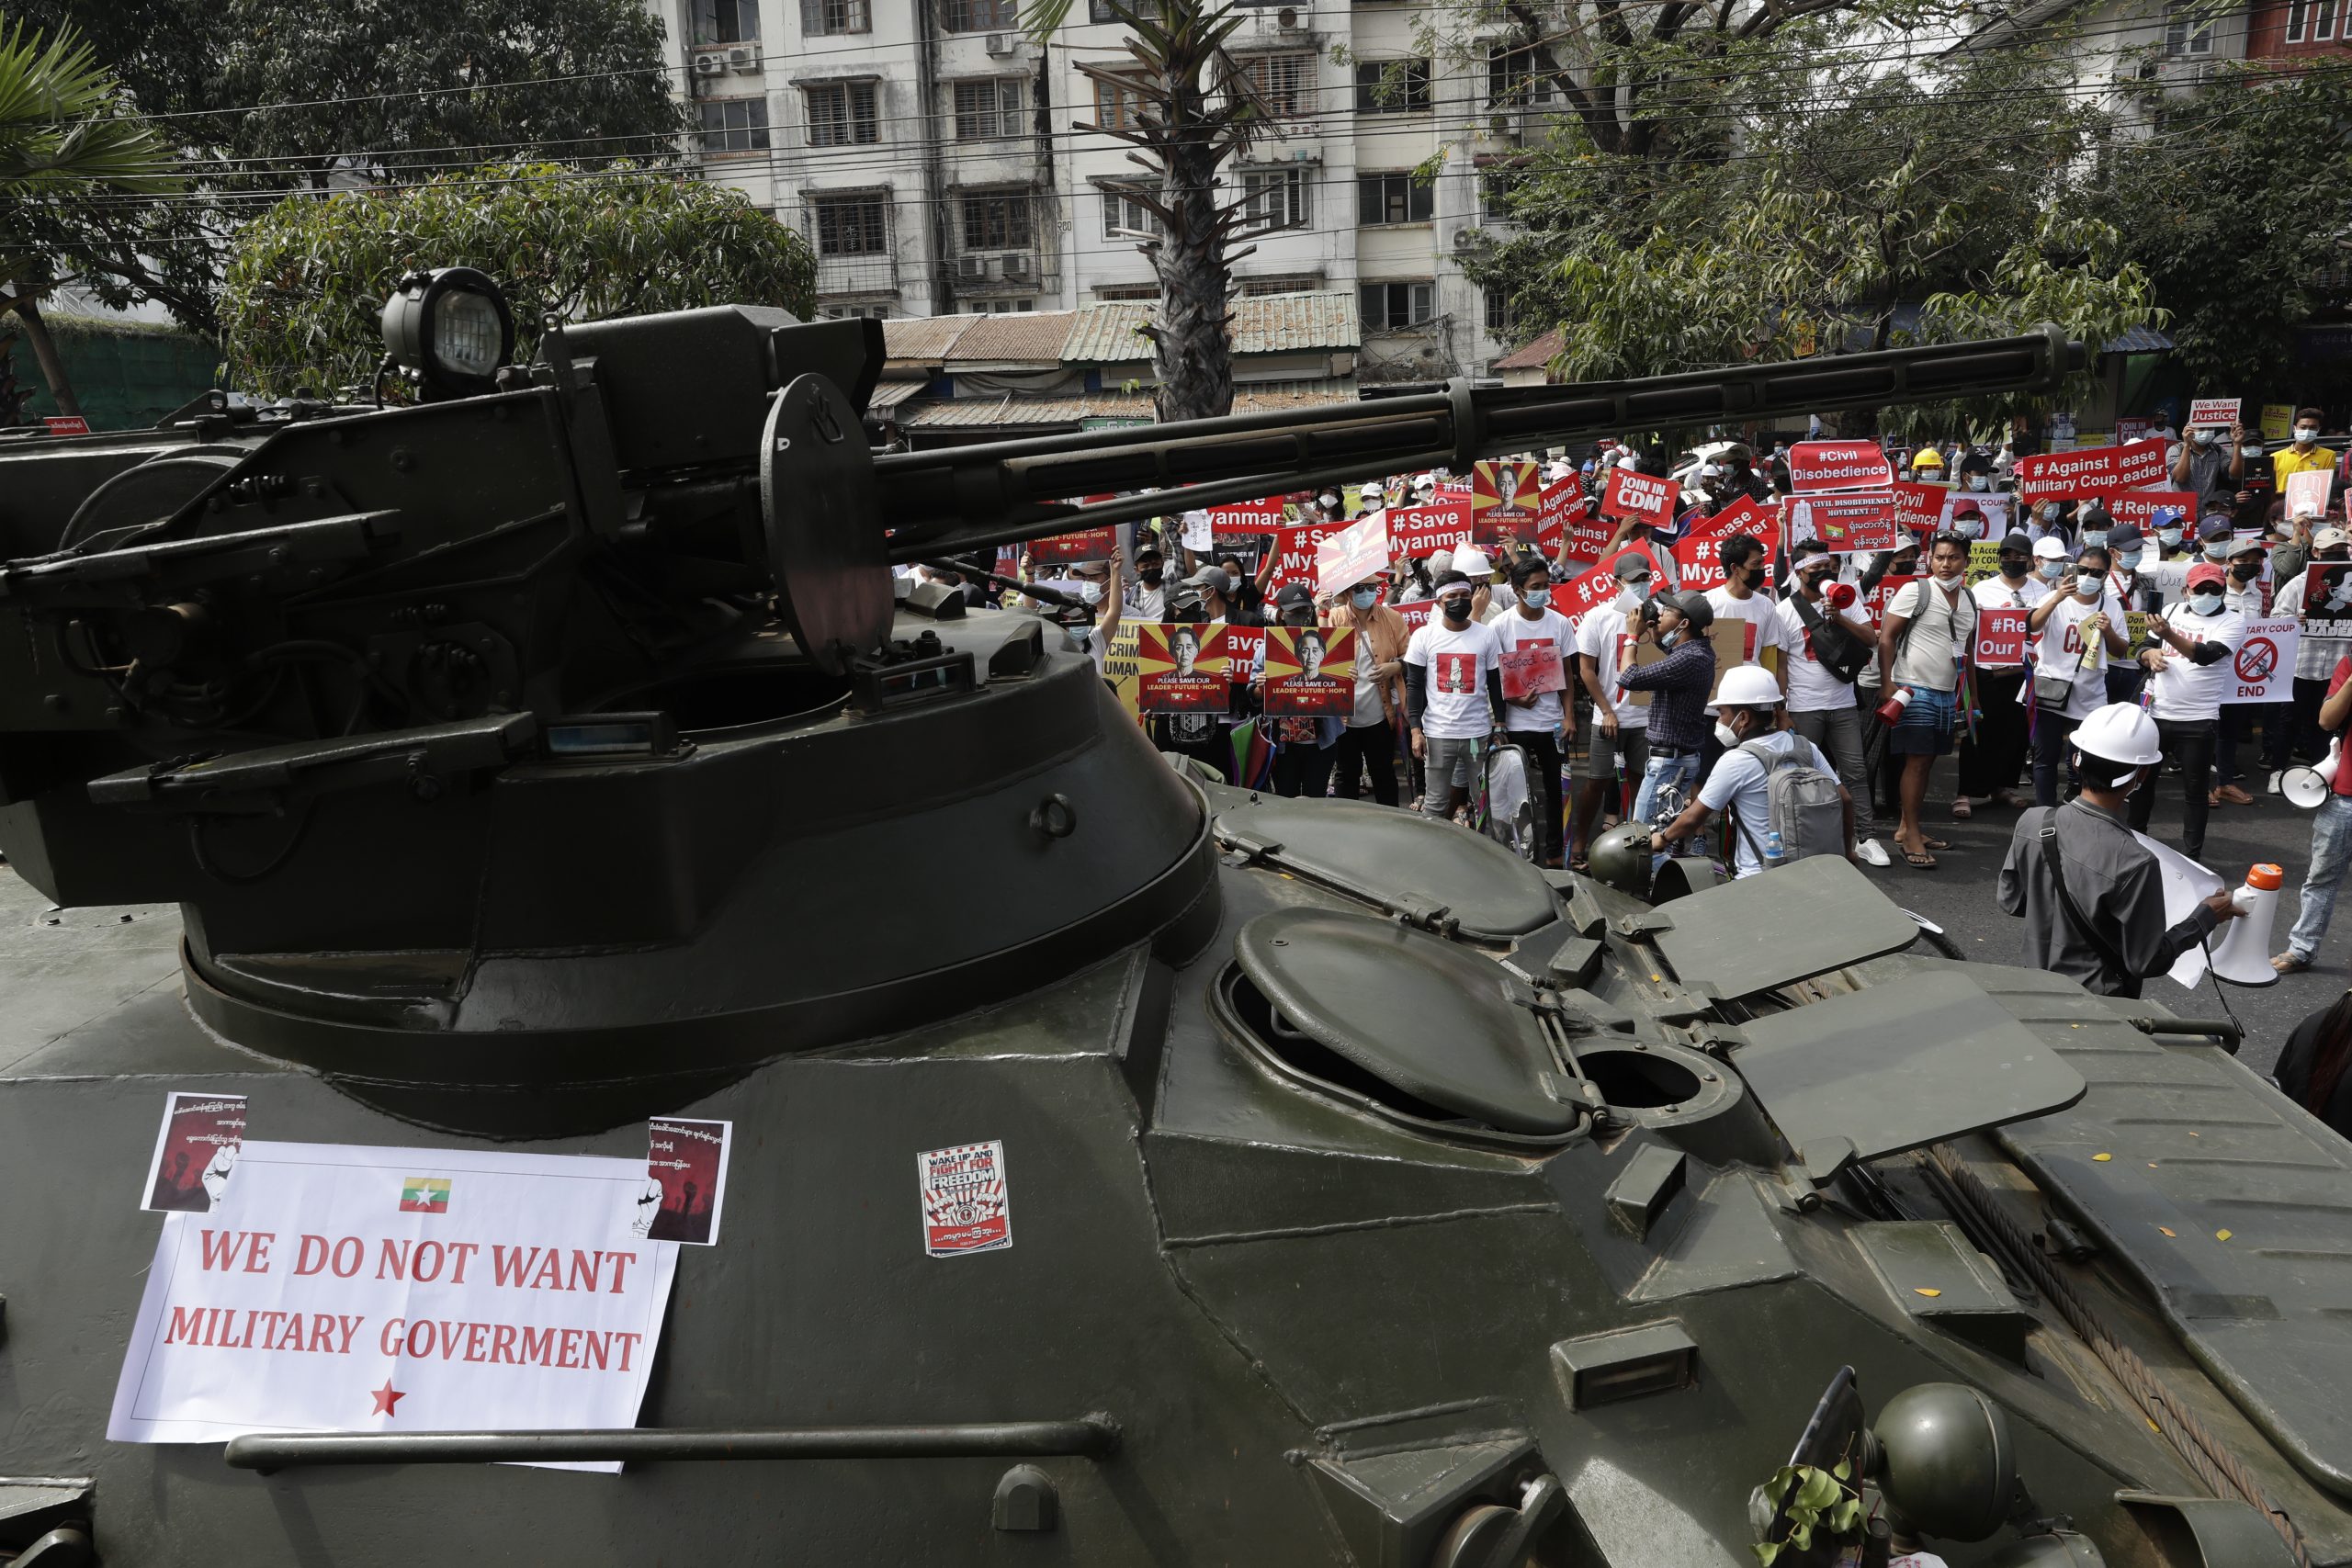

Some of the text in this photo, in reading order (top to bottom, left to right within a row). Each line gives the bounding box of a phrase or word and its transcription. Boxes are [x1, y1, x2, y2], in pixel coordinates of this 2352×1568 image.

[2212, 400, 2238, 409] Want
[2193, 411, 2236, 422] Justice
[1819, 451, 1858, 462] #Civil
[1792, 465, 1887, 481] Disobedience
[2047, 456, 2109, 477] Against
[1653, 482, 1667, 496] IN
[2025, 474, 2118, 494] Military Coup
[1544, 482, 1577, 513] Against
[1813, 497, 1892, 508] CIVIL DISOBEDIENCE
[1564, 497, 1584, 516] Coup
[1827, 508, 1870, 517] MOVEMENT
[1408, 511, 1459, 530] Save
[2269, 624, 2296, 633] COUP
[1980, 640, 2016, 655] Our
[1501, 653, 1557, 671] Respect Our
[1305, 680, 1322, 688] SAVE
[1322, 680, 1337, 688] OUR
[2237, 686, 2266, 698] END
[929, 1149, 993, 1167] WAKE UP AND
[929, 1156, 993, 1176] FIGHT FOR
[931, 1168, 995, 1190] FREEDOM
[201, 1229, 637, 1294] WE DO NOT WANT
[164, 1306, 642, 1372] MILITARY GOVERMENT
